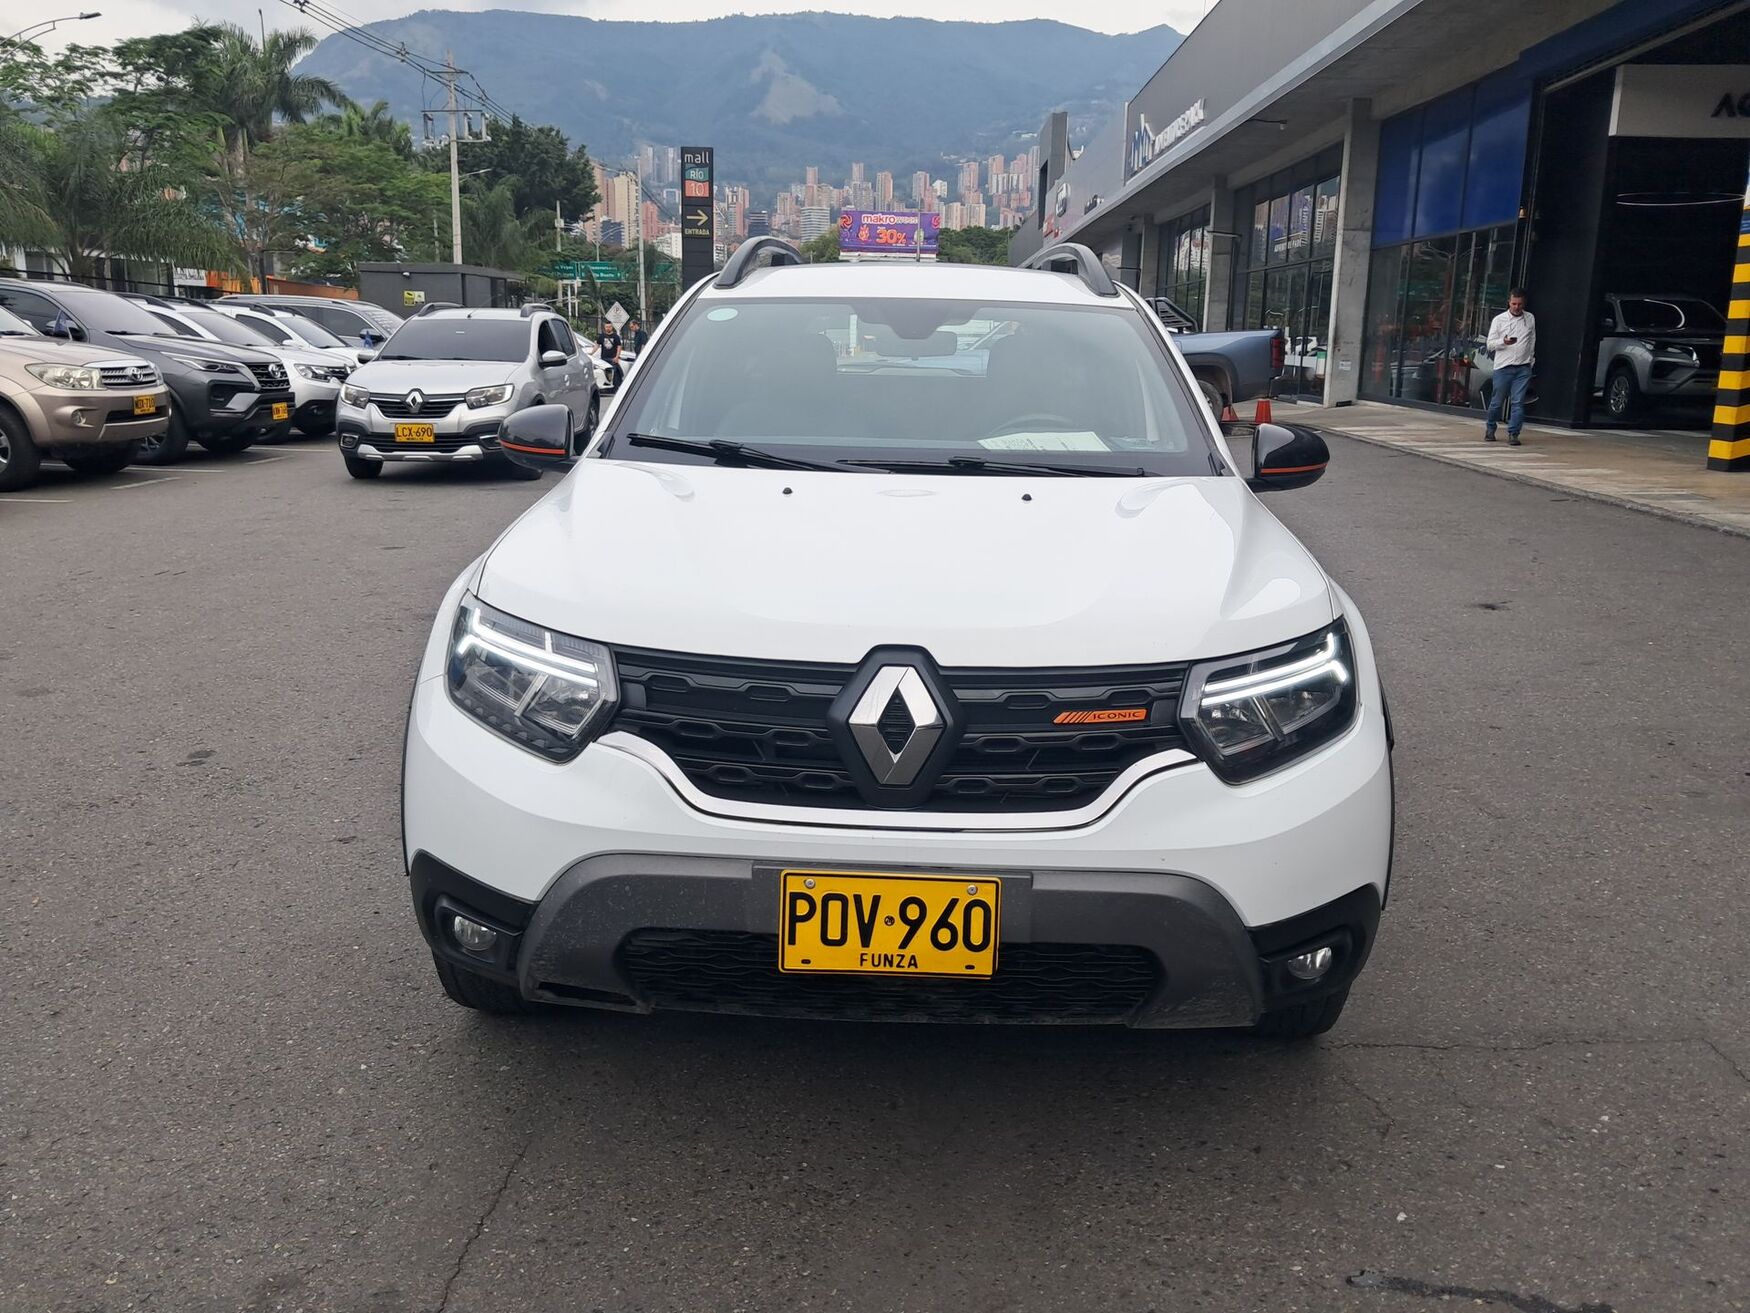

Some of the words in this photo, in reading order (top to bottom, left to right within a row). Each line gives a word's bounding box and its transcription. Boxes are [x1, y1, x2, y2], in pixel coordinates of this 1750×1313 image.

[684, 151, 710, 164] mall
[690, 183, 704, 197] 10
[684, 228, 710, 236] ENTRADA
[876, 229, 907, 244] 30%
[1093, 711, 1141, 720] ICONIC
[859, 952, 919, 969] FUNZA
